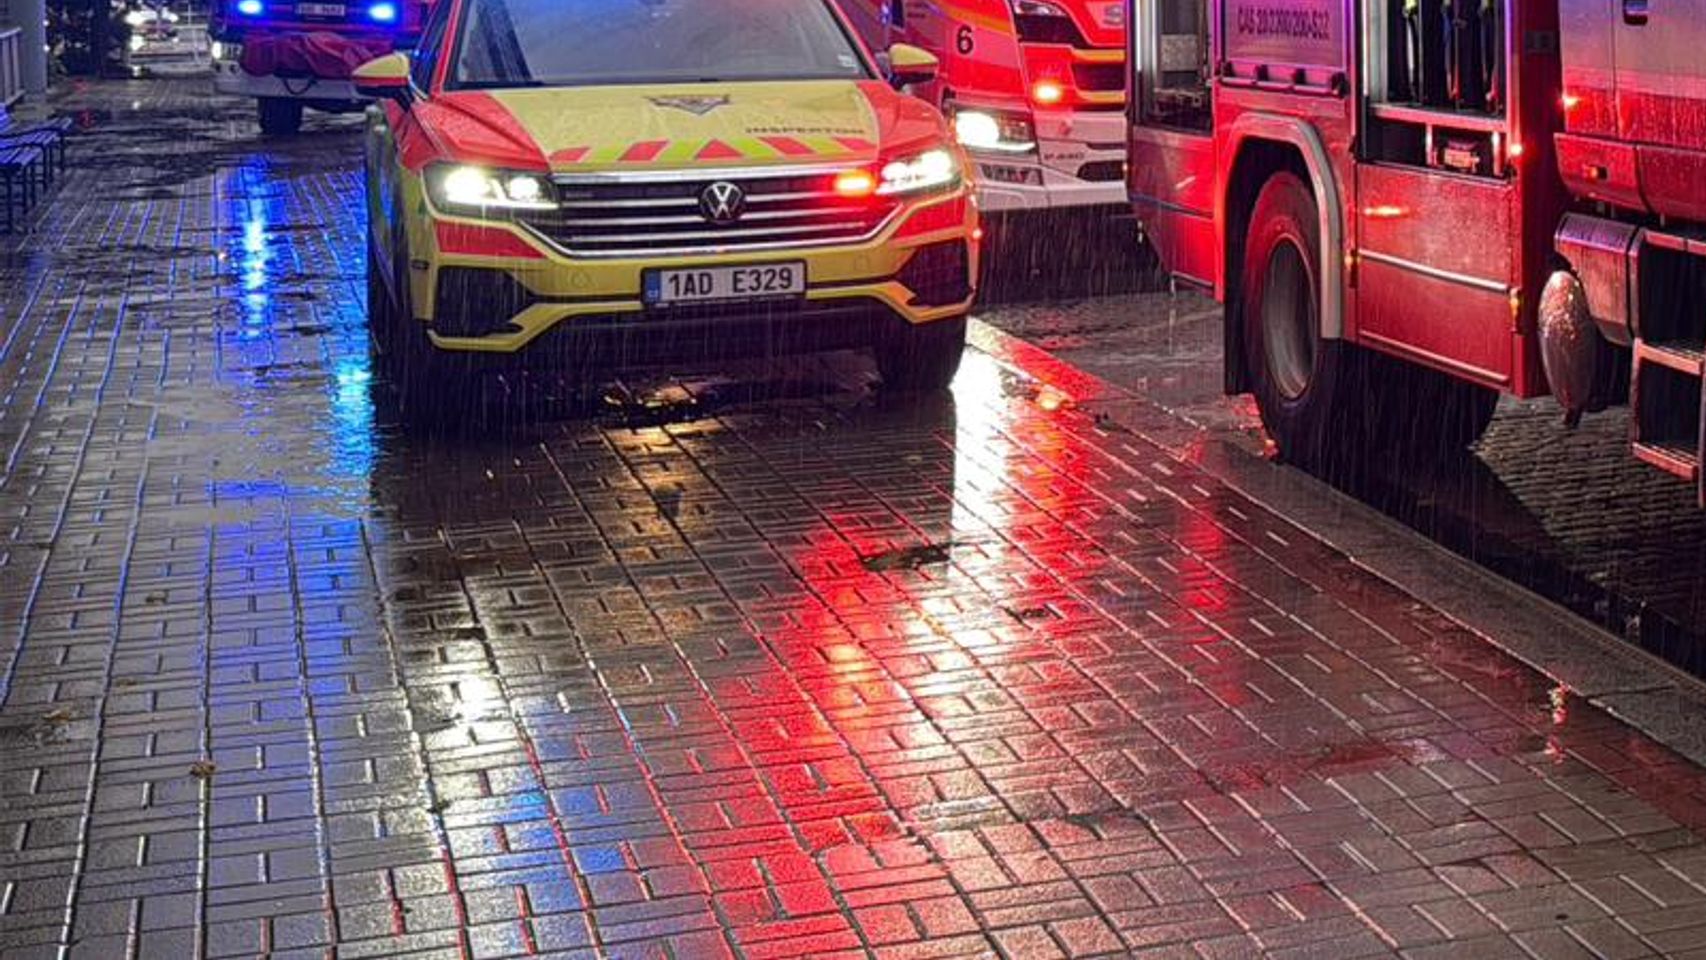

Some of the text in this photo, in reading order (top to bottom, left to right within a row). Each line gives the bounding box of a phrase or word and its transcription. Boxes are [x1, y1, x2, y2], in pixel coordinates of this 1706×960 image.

[957, 25, 973, 54] 6
[668, 267, 793, 297] 1AD E329
